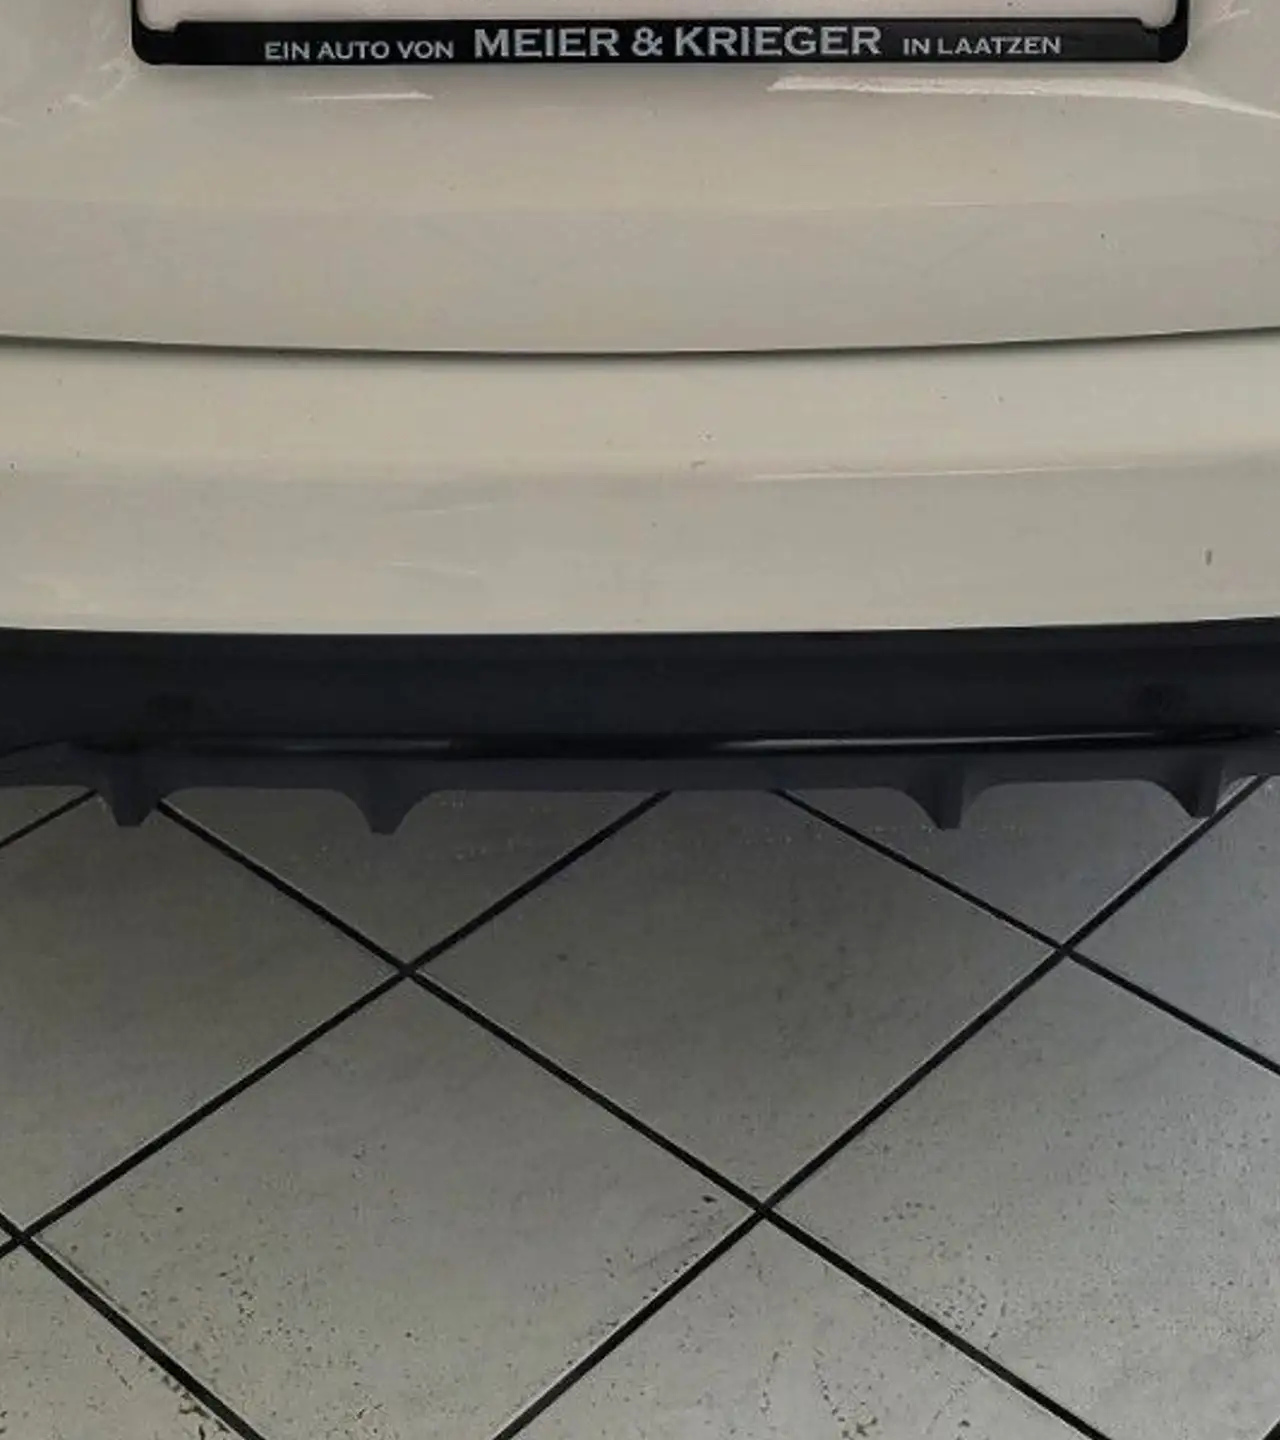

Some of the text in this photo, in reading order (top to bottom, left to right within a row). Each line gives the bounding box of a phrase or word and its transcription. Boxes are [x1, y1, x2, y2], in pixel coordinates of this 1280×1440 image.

[264, 25, 1062, 60] EIN AUTO VON MEIER & KRIEGER IN LAATZEN
